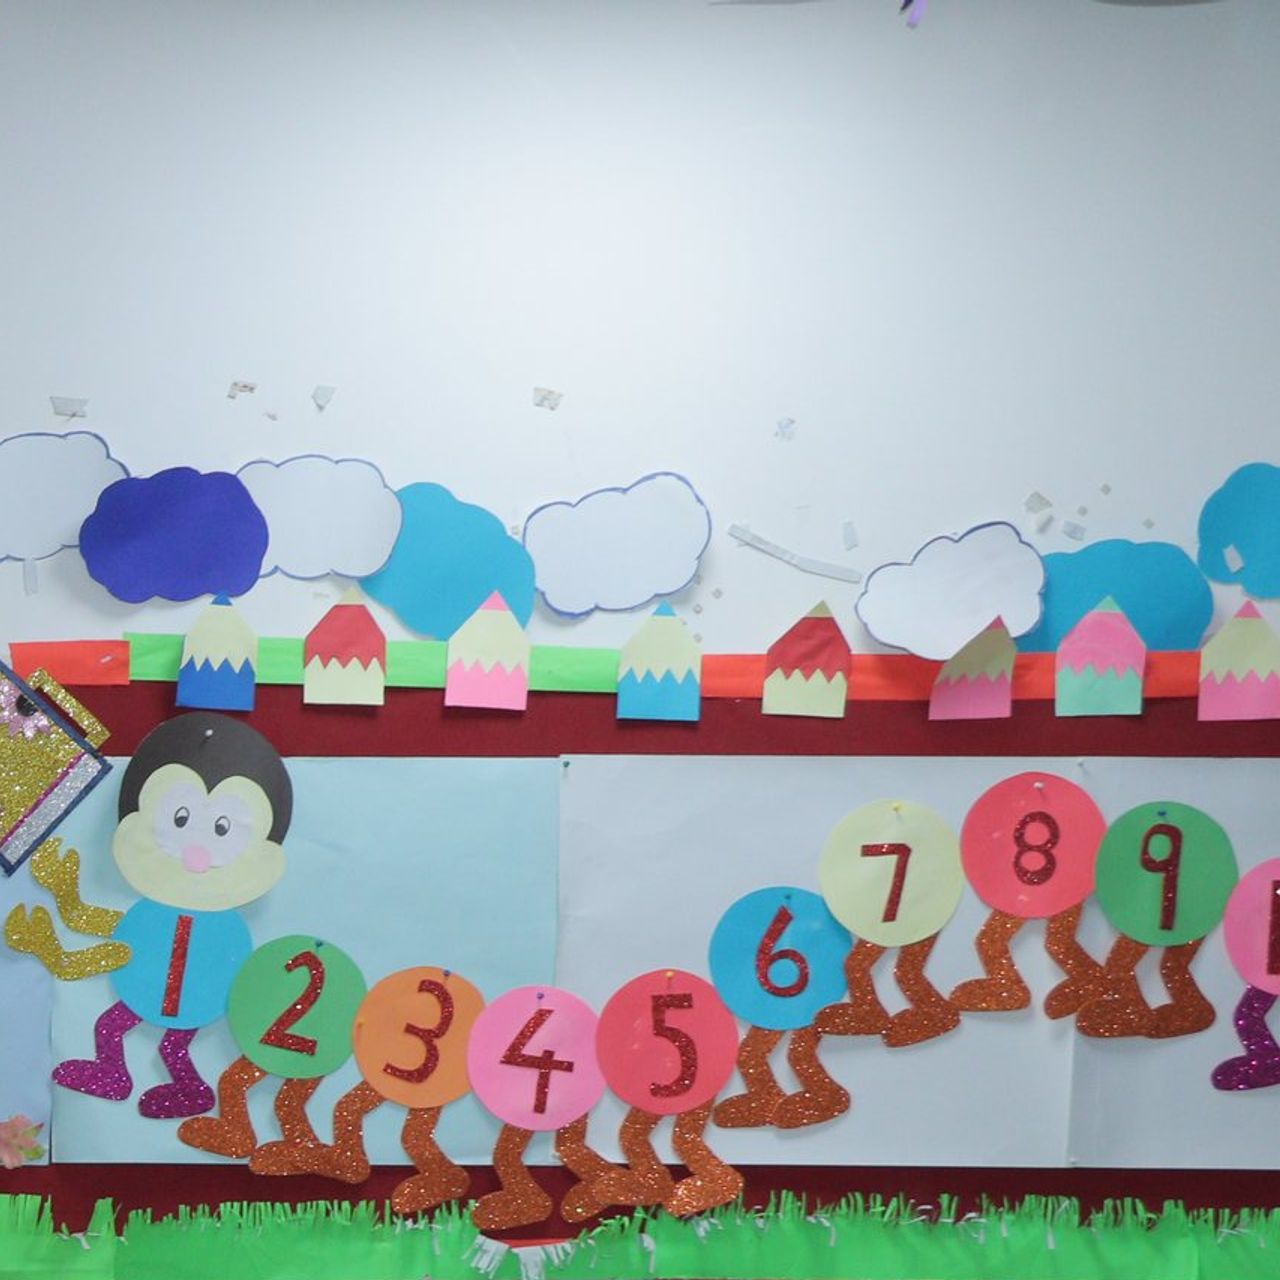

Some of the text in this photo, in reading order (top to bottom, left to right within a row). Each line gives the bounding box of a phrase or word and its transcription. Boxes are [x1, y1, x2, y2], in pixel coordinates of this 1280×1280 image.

[860, 842, 912, 924] 7
[1013, 811, 1060, 886] 8
[1140, 823, 1183, 931] 9
[160, 914, 194, 1018] 1
[259, 950, 327, 1055] 2
[756, 904, 810, 998] 6
[382, 978, 455, 1084] 3
[499, 1008, 575, 1115] 4
[648, 992, 700, 1098] 5
